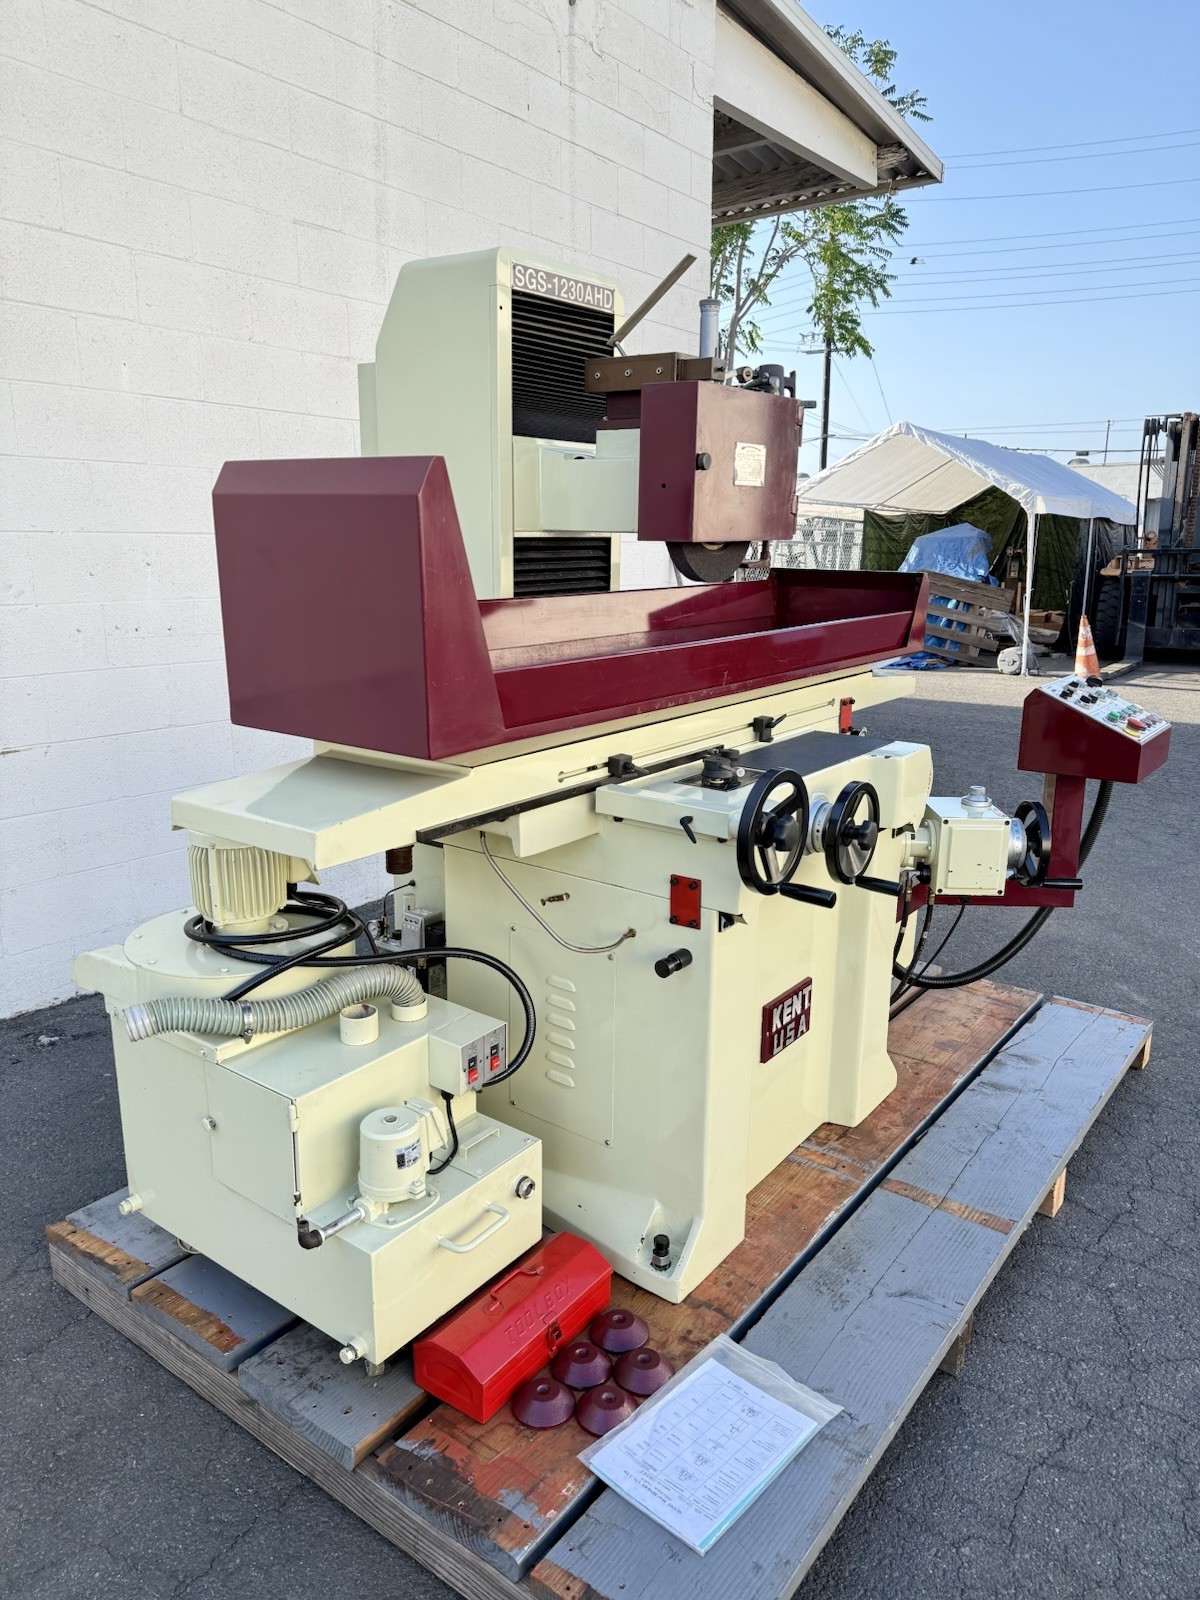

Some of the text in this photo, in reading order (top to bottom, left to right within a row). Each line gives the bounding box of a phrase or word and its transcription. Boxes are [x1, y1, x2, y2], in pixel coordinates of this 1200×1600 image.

[515, 265, 613, 309] SGS-1230AHD
[772, 984, 812, 1033] KENT
[772, 1014, 807, 1056] USA
